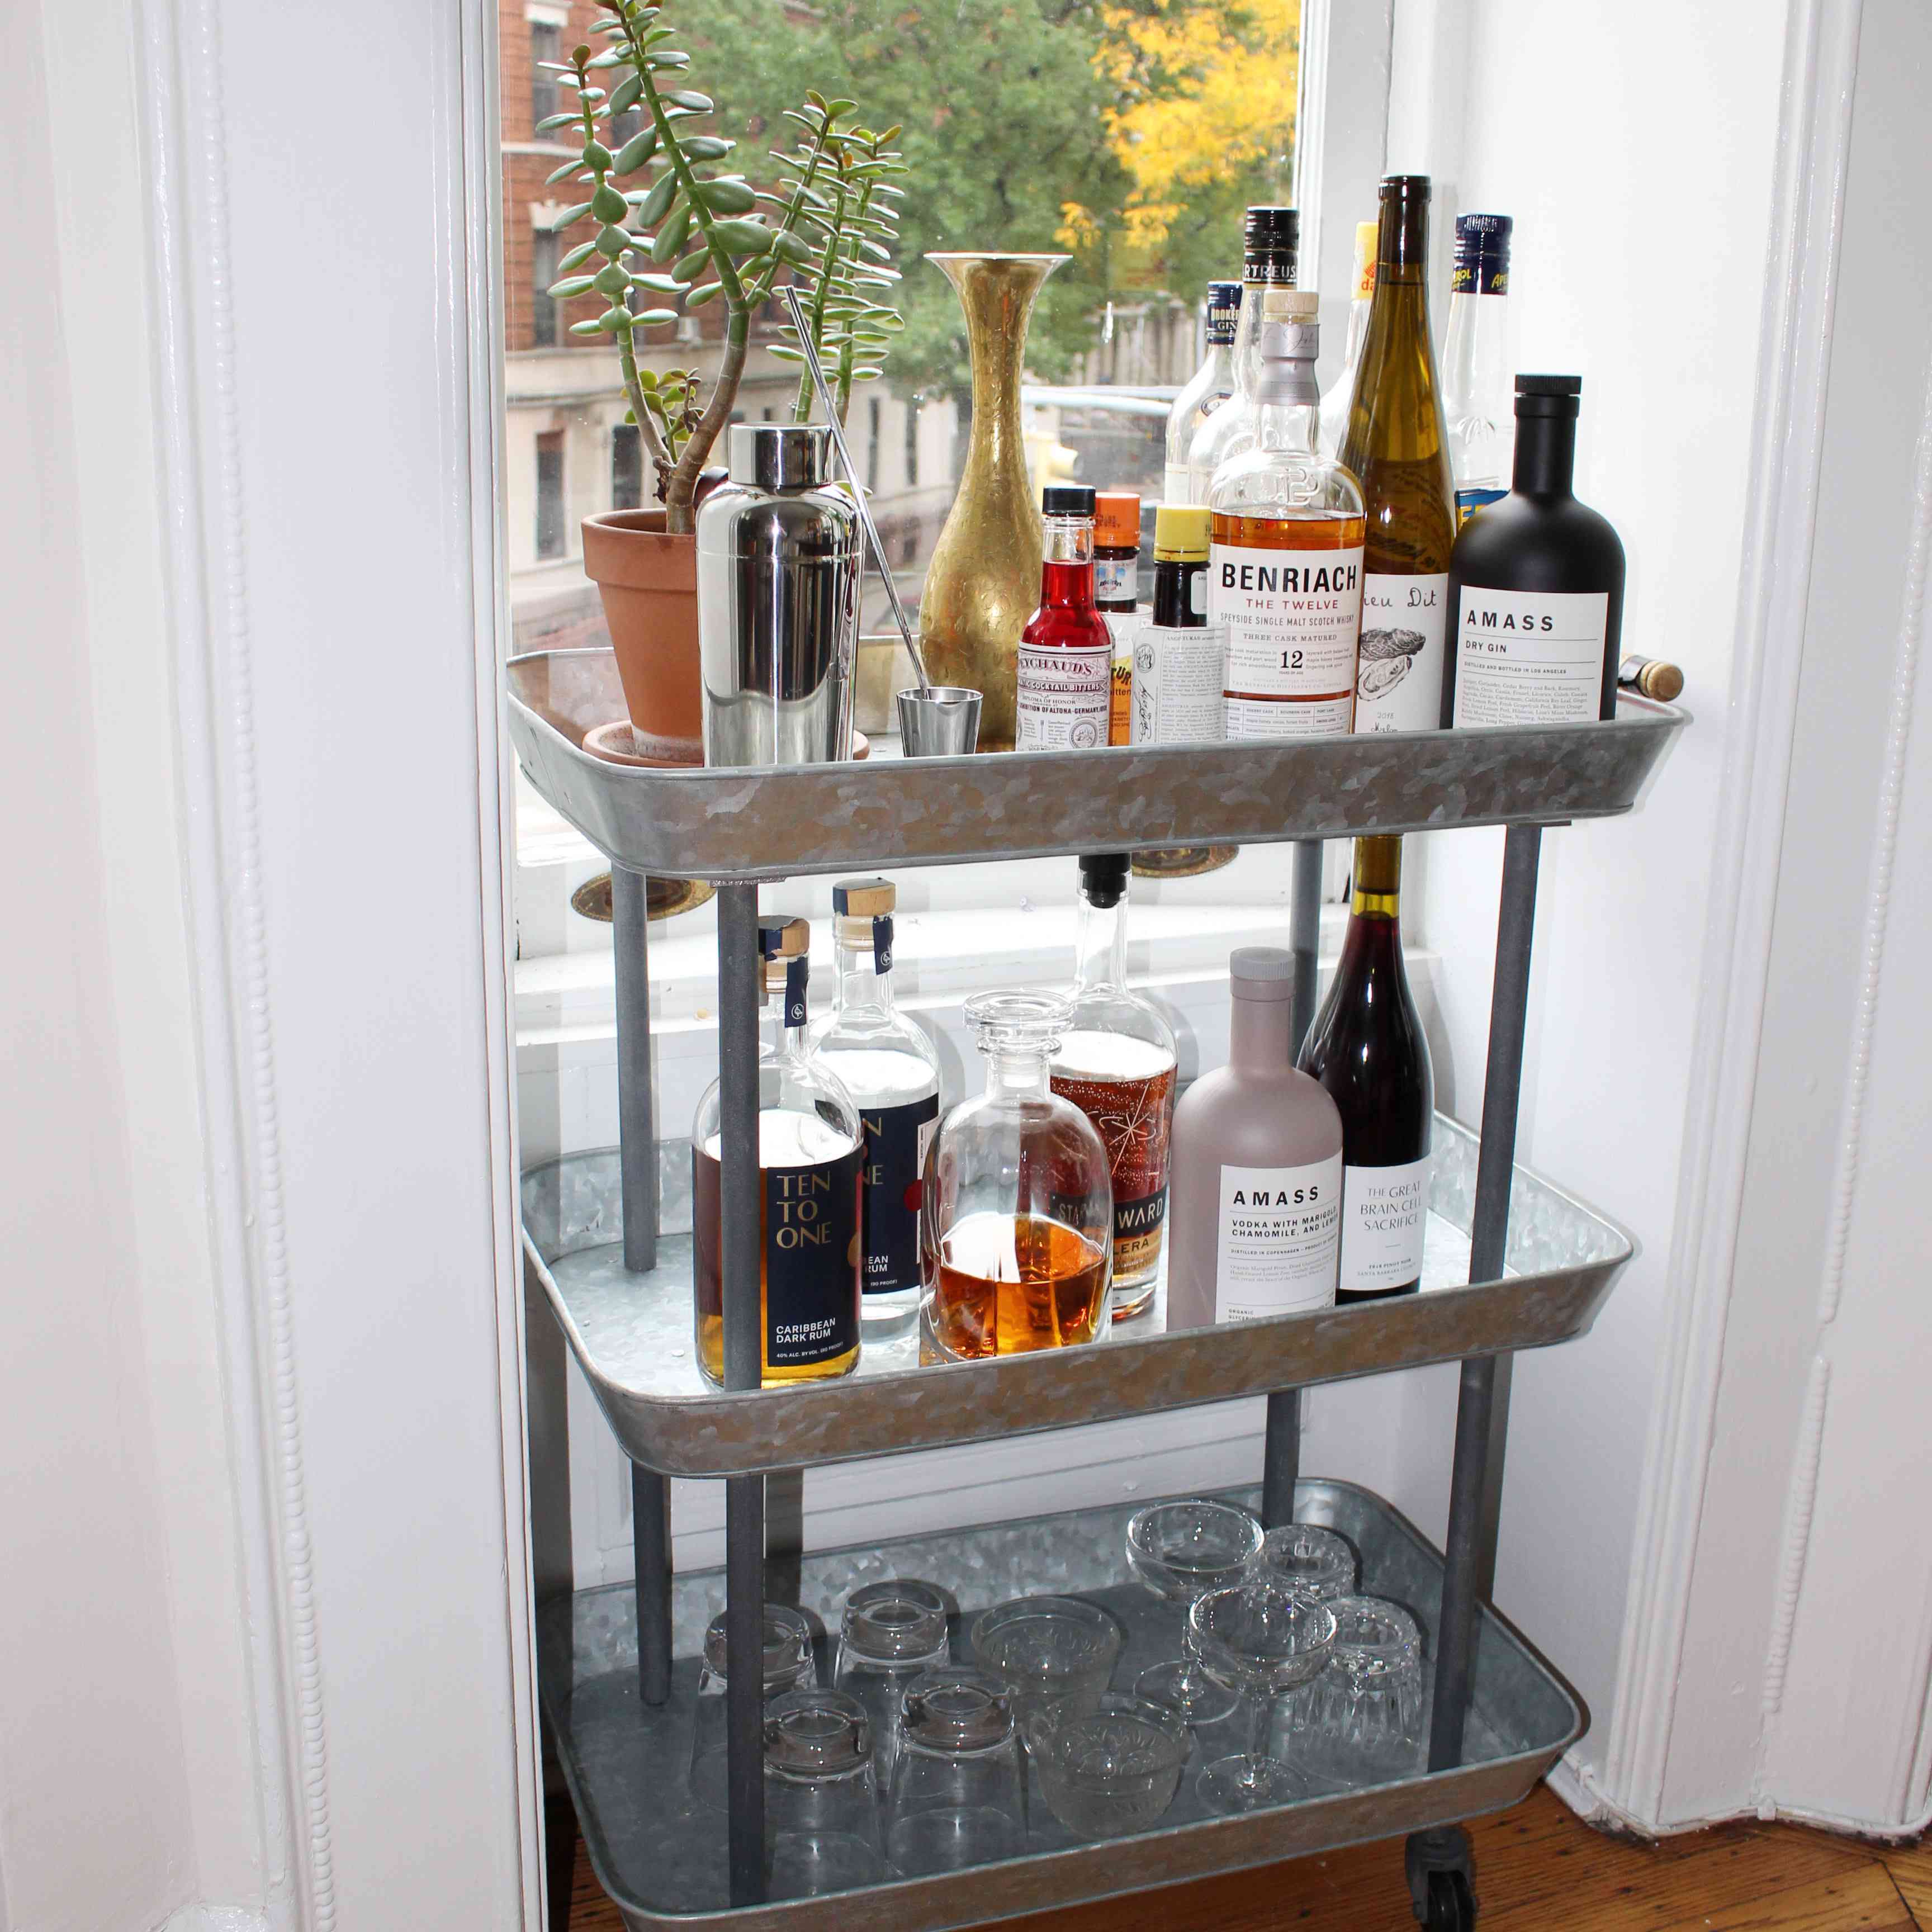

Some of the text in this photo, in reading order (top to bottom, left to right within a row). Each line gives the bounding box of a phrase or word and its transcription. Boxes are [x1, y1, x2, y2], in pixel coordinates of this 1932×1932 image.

[1222, 563, 1357, 593] BENRIACH
[1246, 599, 1338, 610] THE TWELVE
[1364, 587, 1437, 607] ieu Dit
[1220, 613, 1354, 627] SPEYSIDE SINGLE MALT SCOTCH WHISKY
[1467, 610, 1553, 631] AMASS
[1243, 633, 1272, 641] THREE
[1466, 641, 1507, 653] DRY GIN
[1281, 650, 1303, 669] 12
[1032, 680, 1068, 692] COCKTAIL
[1070, 683, 1100, 692] BITTERS
[776, 1170, 831, 1197] TEN
[1368, 1180, 1422, 1198] THE GREAT
[1233, 1186, 1318, 1206] AMASS
[776, 1200, 818, 1223] TO
[1361, 1203, 1398, 1215] BRAIN
[1232, 1219, 1268, 1228] VODKA
[1273, 1219, 1298, 1228] WITH
[1364, 1213, 1418, 1231] SACRIFICE
[776, 1221, 832, 1248] ONE
[1232, 1229, 1299, 1238] CHAMOMILE,
[1304, 1224, 1319, 1234] AND
[868, 1256, 888, 1264] EAN
[776, 1317, 836, 1334] CARIBBEAN
[776, 1328, 831, 1343] DARK RUM
